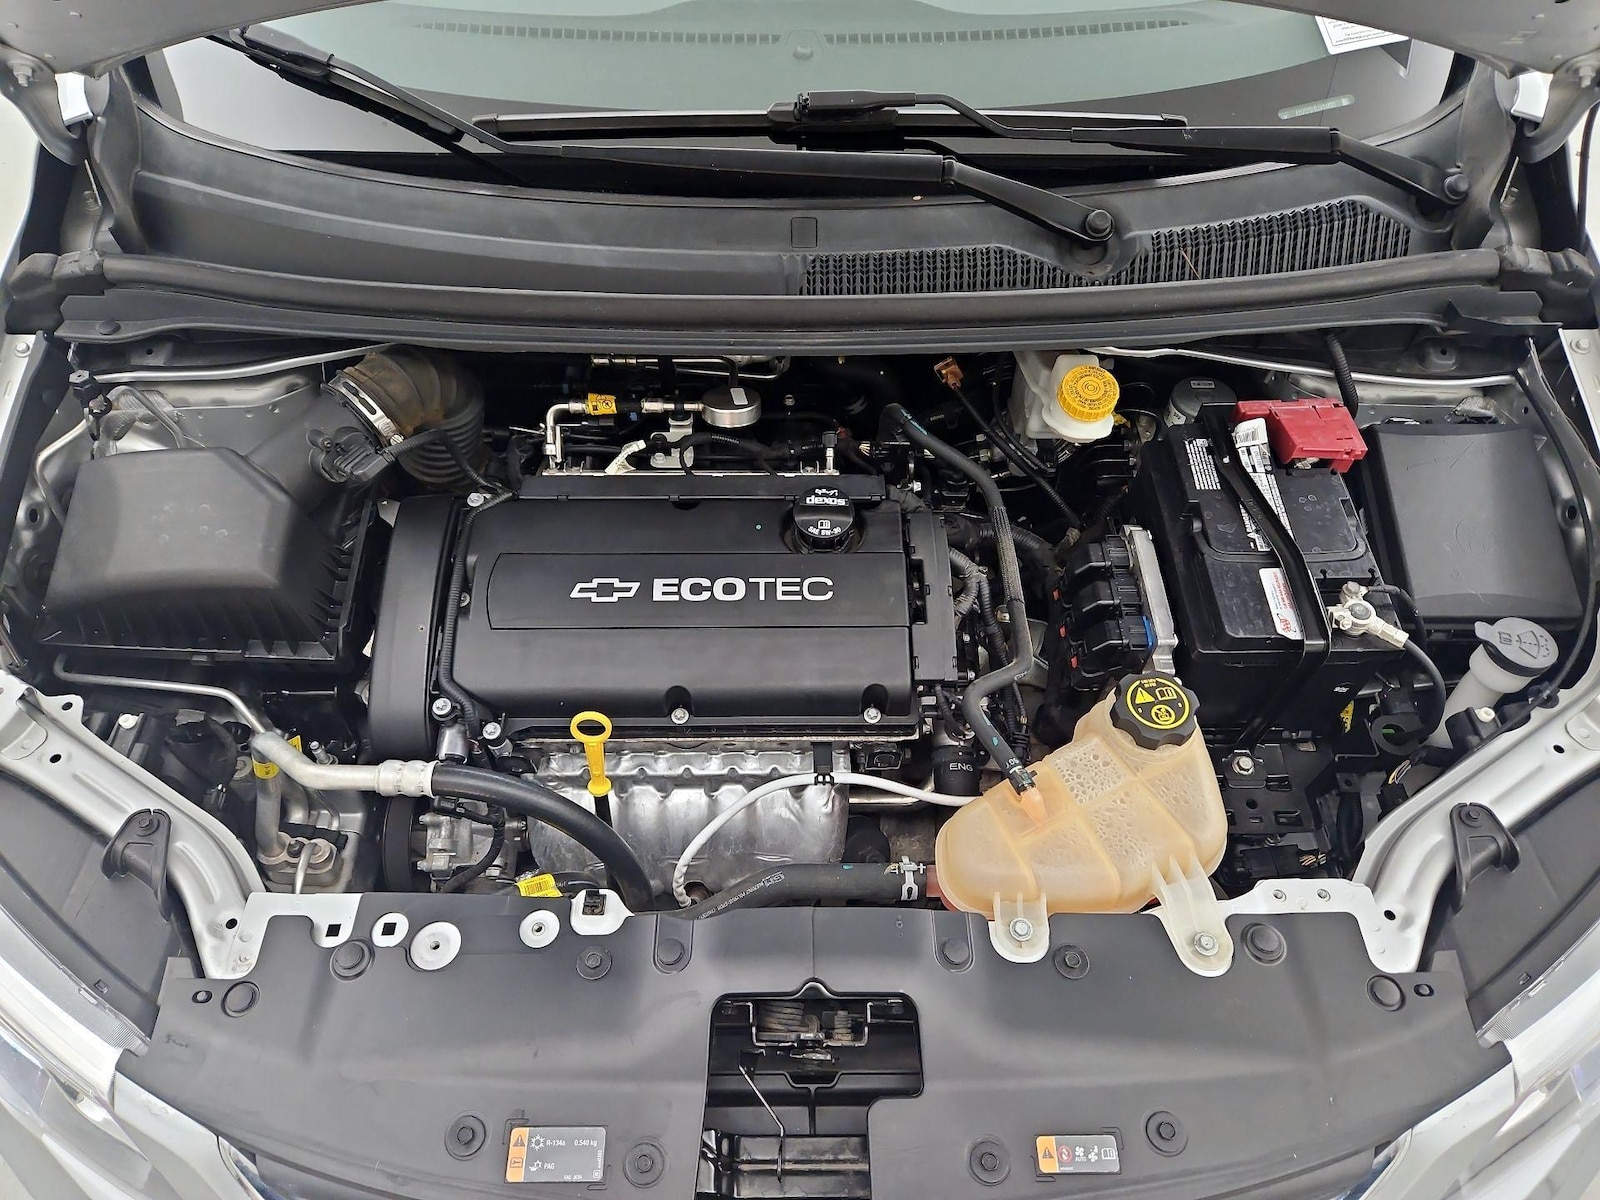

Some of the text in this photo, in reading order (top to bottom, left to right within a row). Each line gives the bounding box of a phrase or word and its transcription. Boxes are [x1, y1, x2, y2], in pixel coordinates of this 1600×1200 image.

[806, 495, 846, 505] dexos
[652, 577, 834, 602] ECOTEC
[949, 762, 974, 772] ENG
[590, 1140, 598, 1148] kg
